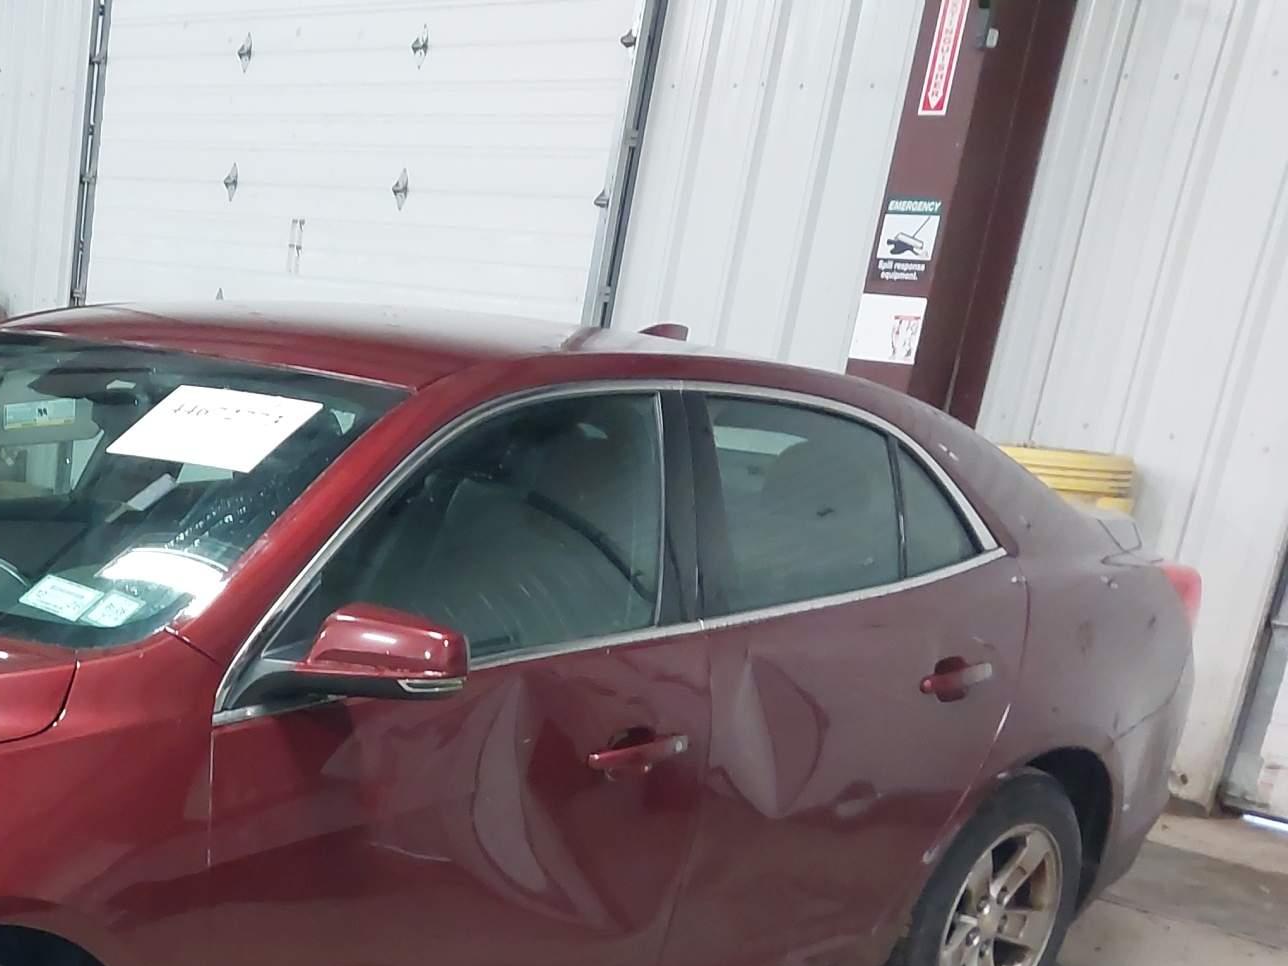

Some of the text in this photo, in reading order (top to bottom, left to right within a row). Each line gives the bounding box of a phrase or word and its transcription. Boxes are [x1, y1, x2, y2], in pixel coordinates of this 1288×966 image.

[888, 200, 941, 211] EMERGENCY
[878, 260, 926, 272] Spill response
